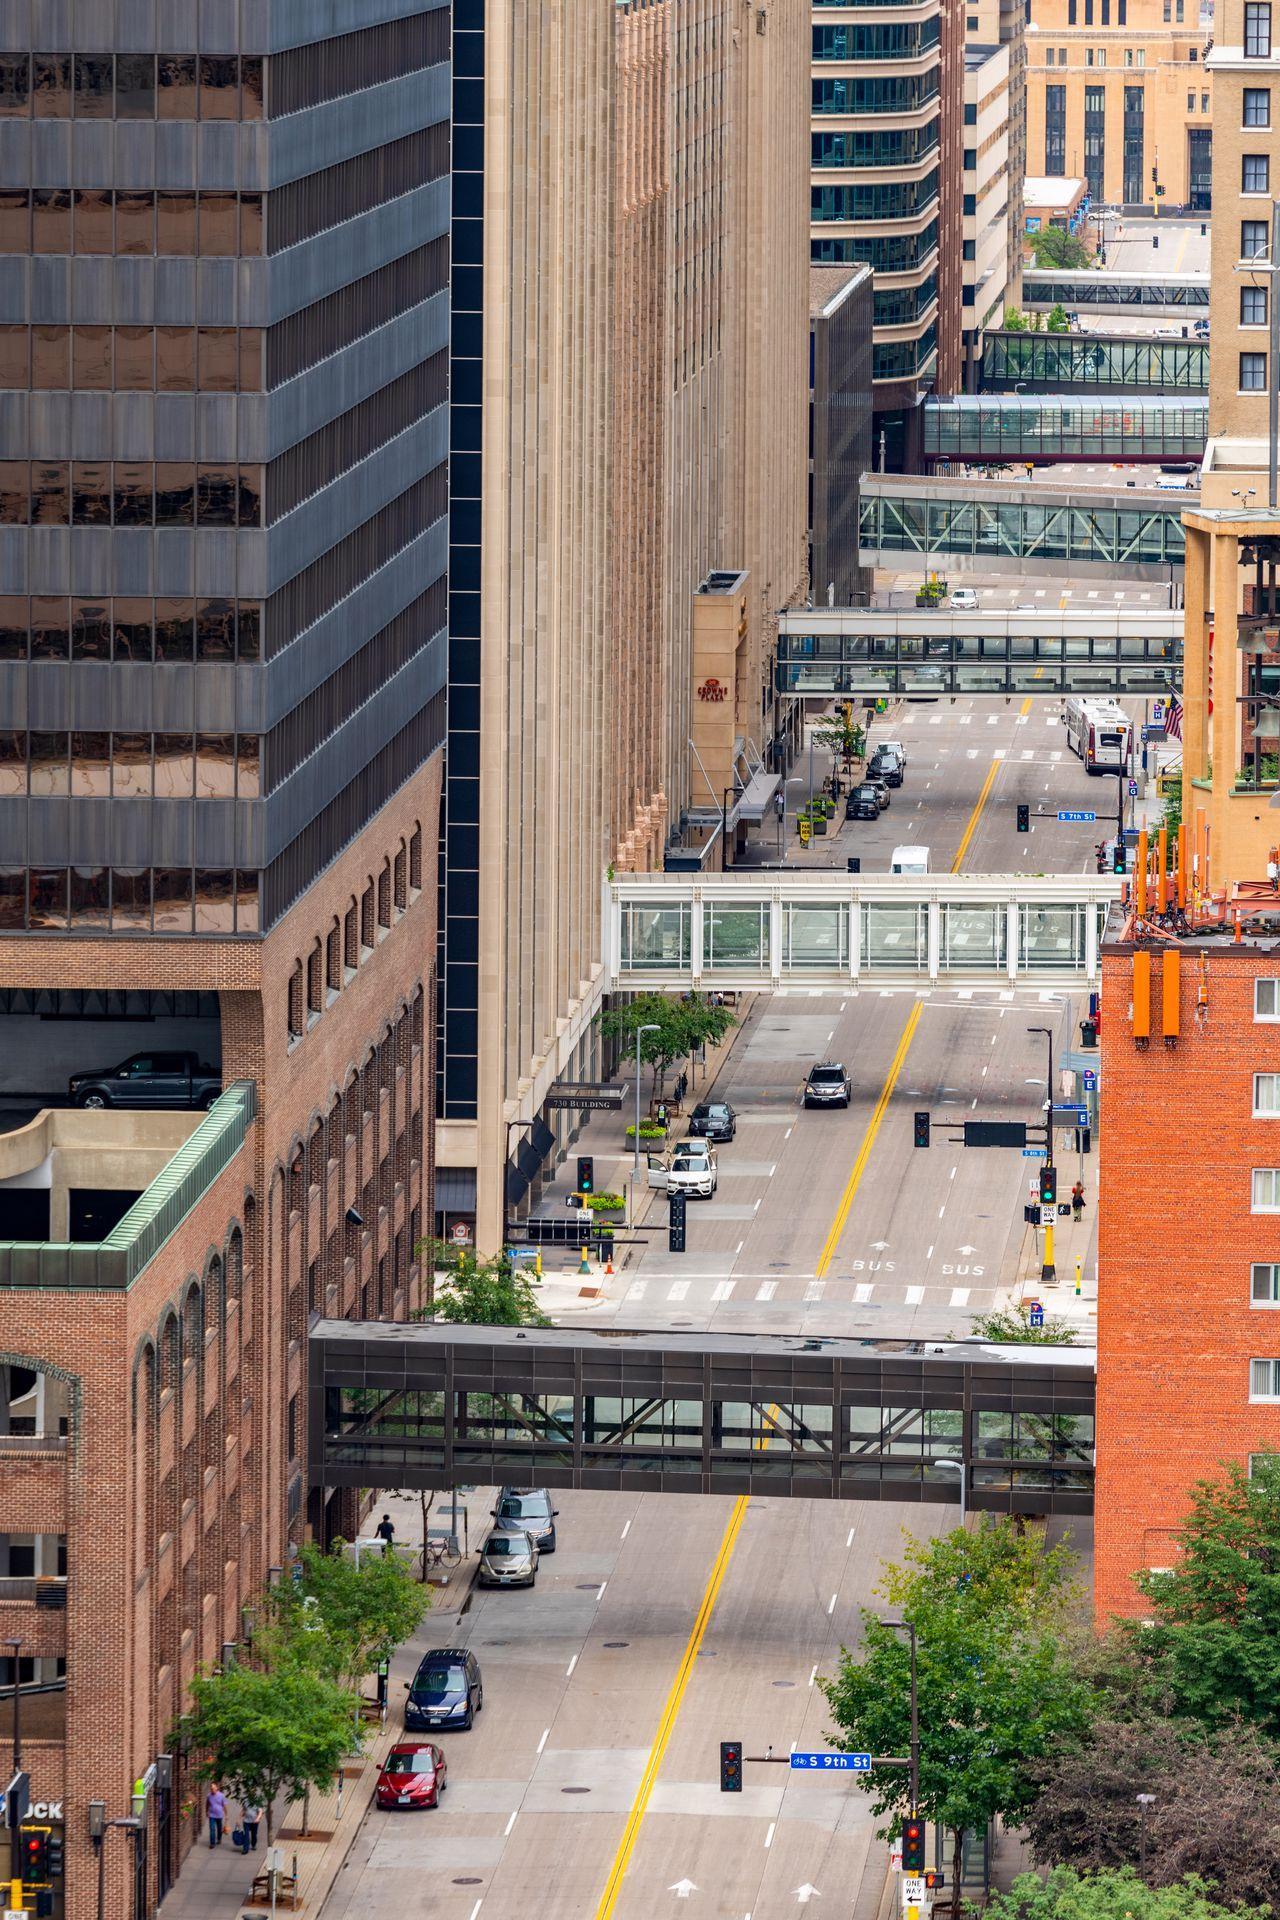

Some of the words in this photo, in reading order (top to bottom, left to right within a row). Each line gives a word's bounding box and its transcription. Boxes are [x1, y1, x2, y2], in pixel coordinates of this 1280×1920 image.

[698, 687, 728, 695] CROWNE
[701, 694, 723, 702] PLAZA
[1086, 1081, 1093, 1089] E
[1080, 1114, 1086, 1122] E
[853, 1260, 896, 1272] BUS
[942, 1264, 985, 1276] BUS
[1033, 1316, 1041, 1325] H
[809, 1756, 818, 1767] S
[824, 1756, 848, 1767] 9th
[853, 1756, 868, 1767] St
[906, 1879, 921, 1887] ONE
